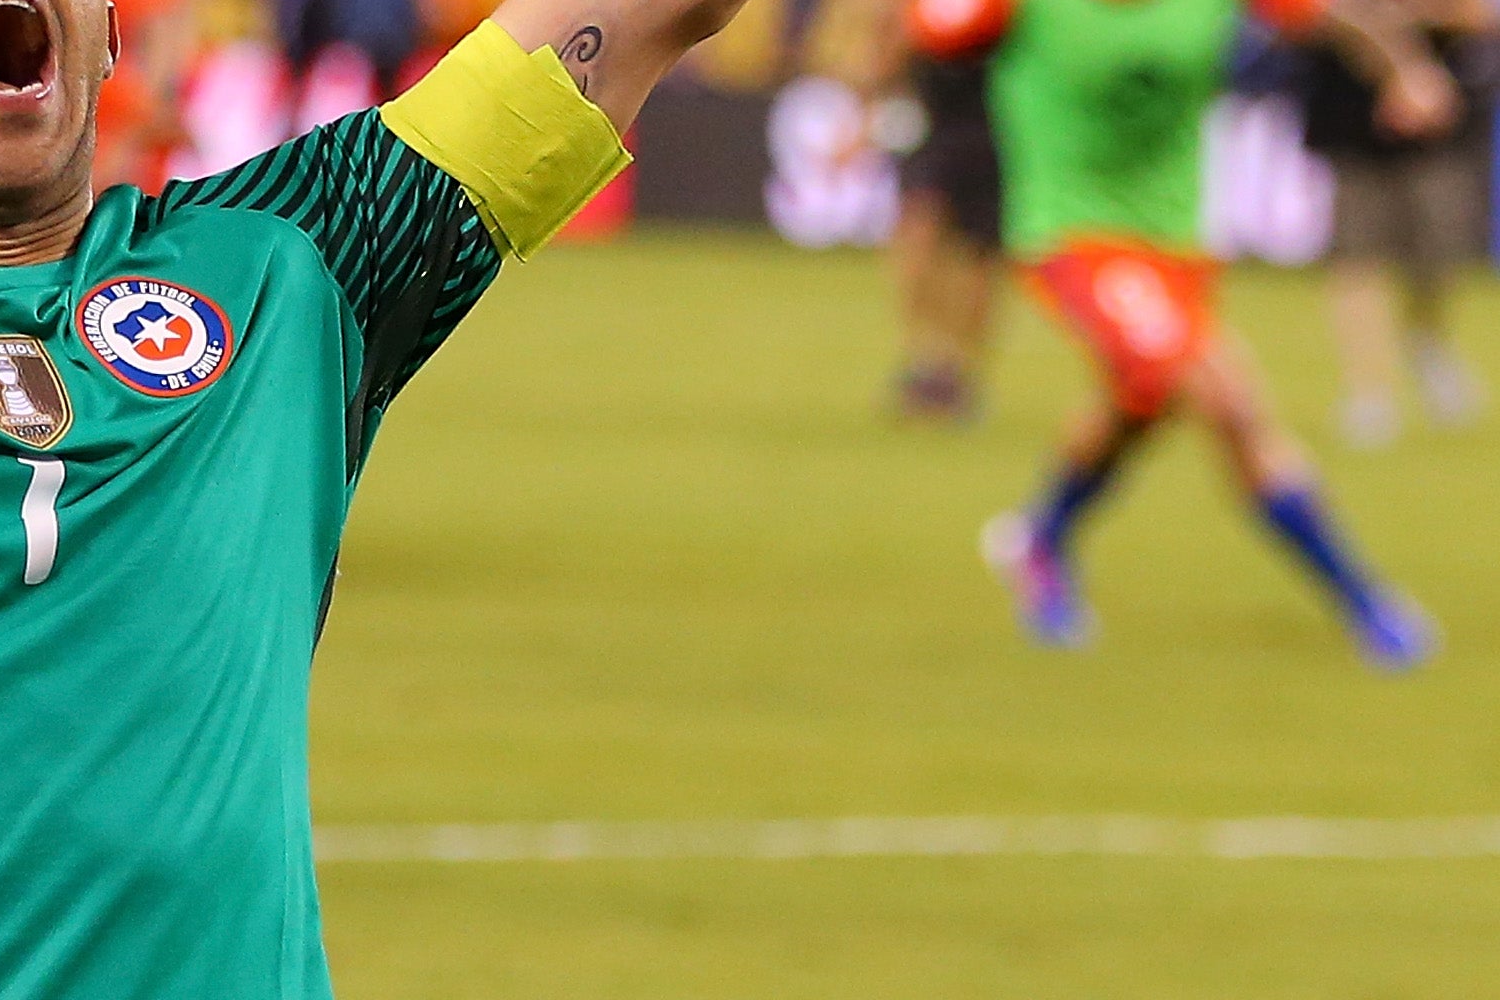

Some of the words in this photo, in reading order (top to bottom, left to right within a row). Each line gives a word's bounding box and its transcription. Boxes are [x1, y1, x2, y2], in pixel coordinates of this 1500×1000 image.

[83, 293, 119, 363] FEDERACION
[110, 281, 133, 299] DE
[138, 281, 197, 308] FUTBOL
[167, 372, 191, 390] DE
[190, 344, 223, 380] CHILE
[16, 456, 66, 586] 1
